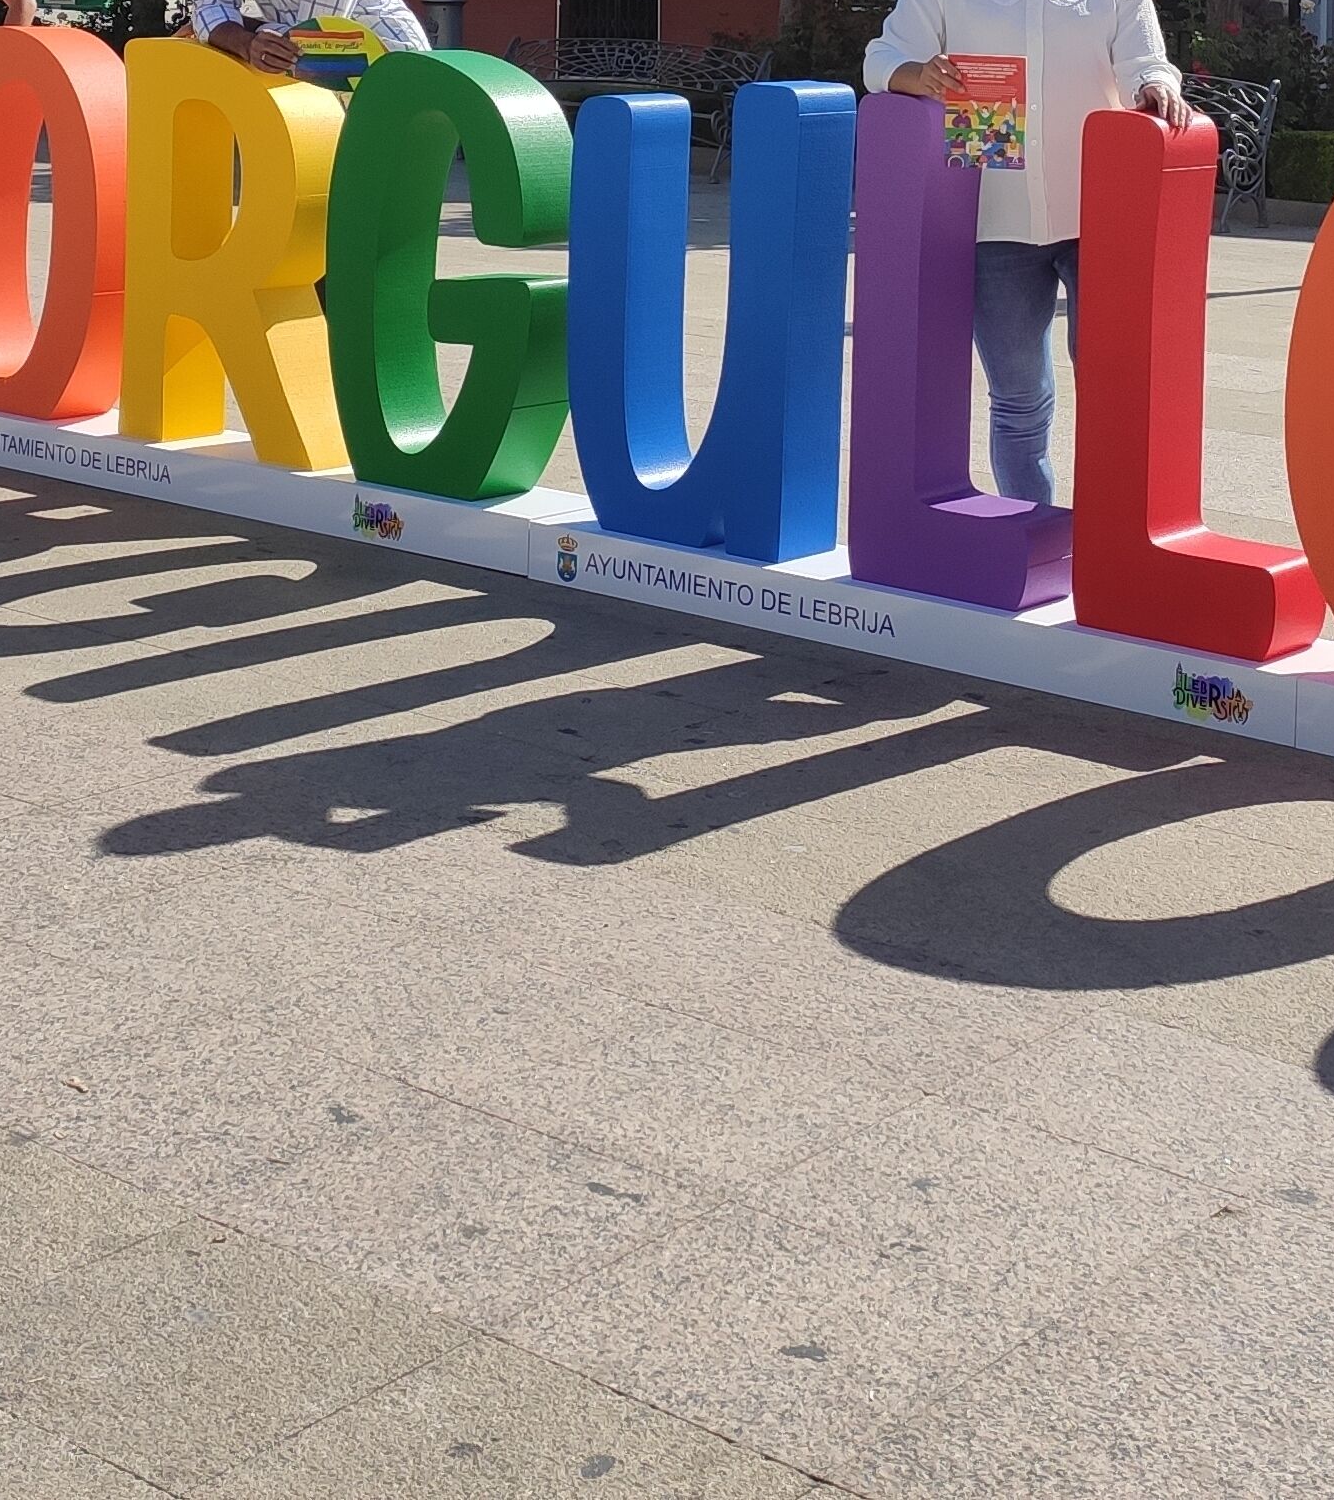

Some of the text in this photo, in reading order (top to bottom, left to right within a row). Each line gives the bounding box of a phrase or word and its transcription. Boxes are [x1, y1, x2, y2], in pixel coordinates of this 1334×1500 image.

[80, 449, 101, 470] DE
[107, 453, 171, 484] LEBRIJA
[584, 552, 896, 638] AYUNTAMIENTO DE LEBRIJA
[1183, 673, 1243, 702] LEBRIJA
